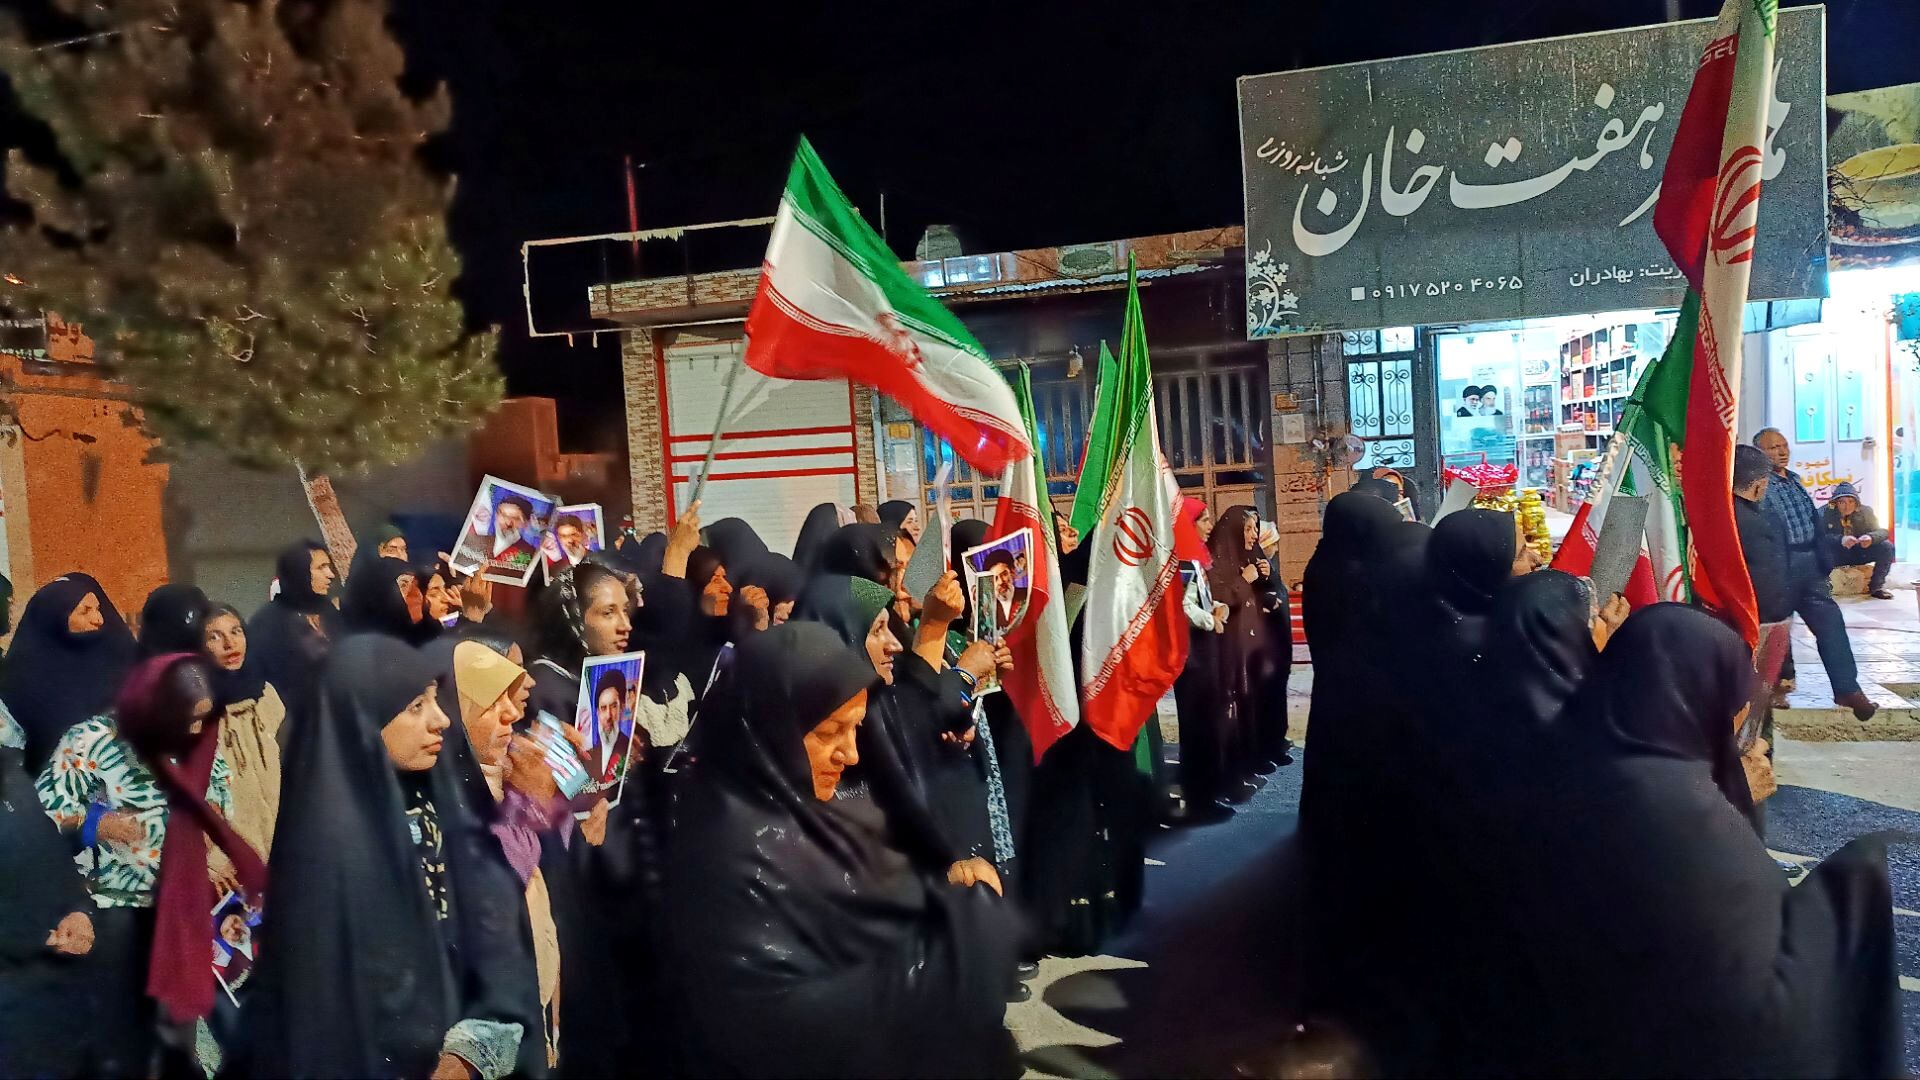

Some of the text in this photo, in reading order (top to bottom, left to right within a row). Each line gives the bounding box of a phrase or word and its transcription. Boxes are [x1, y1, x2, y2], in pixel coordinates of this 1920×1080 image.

[1292, 125, 1445, 257] خان
[1450, 82, 1665, 209] هفت
[1569, 265, 1634, 287] بهادران
